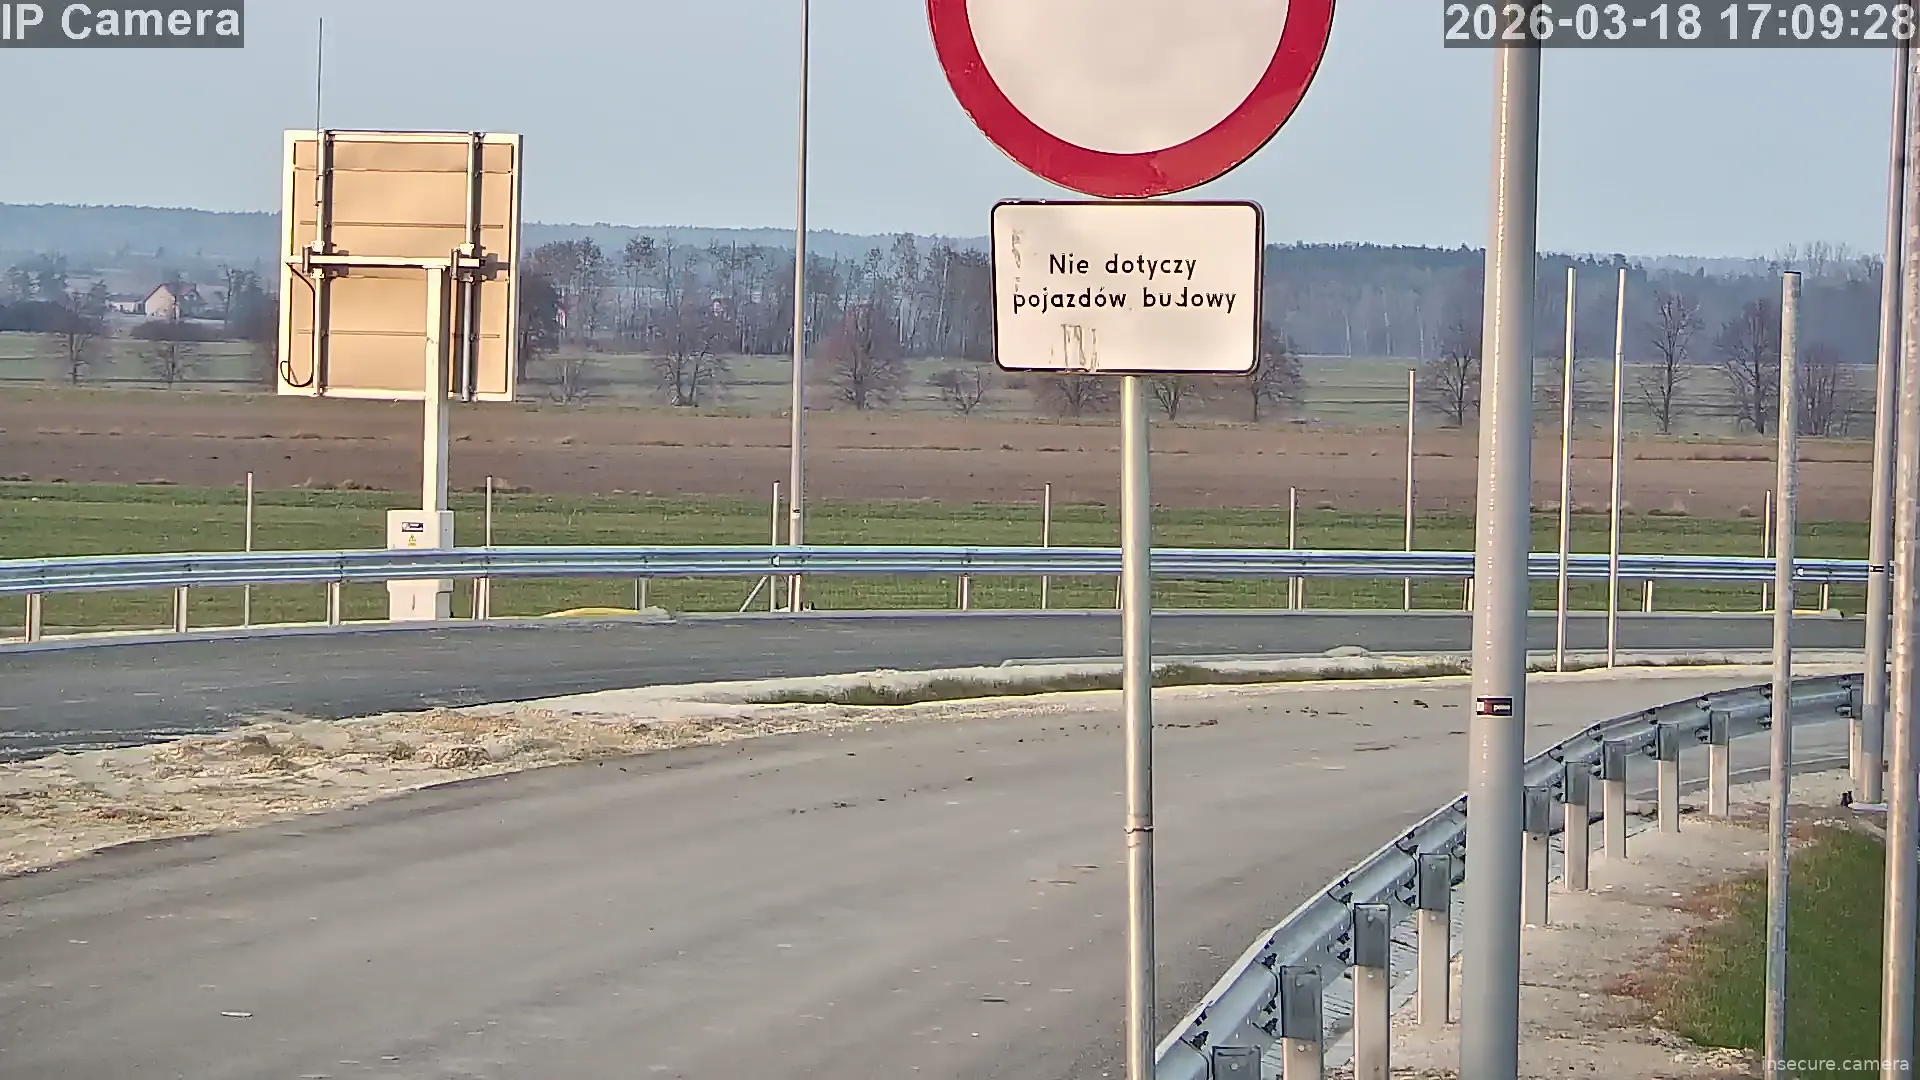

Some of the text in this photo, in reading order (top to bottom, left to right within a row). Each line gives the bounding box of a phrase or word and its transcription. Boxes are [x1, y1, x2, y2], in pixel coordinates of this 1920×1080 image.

[1049, 253, 1197, 281] Nie dotyczy
[1013, 286, 1237, 314] pojazdów budowy
